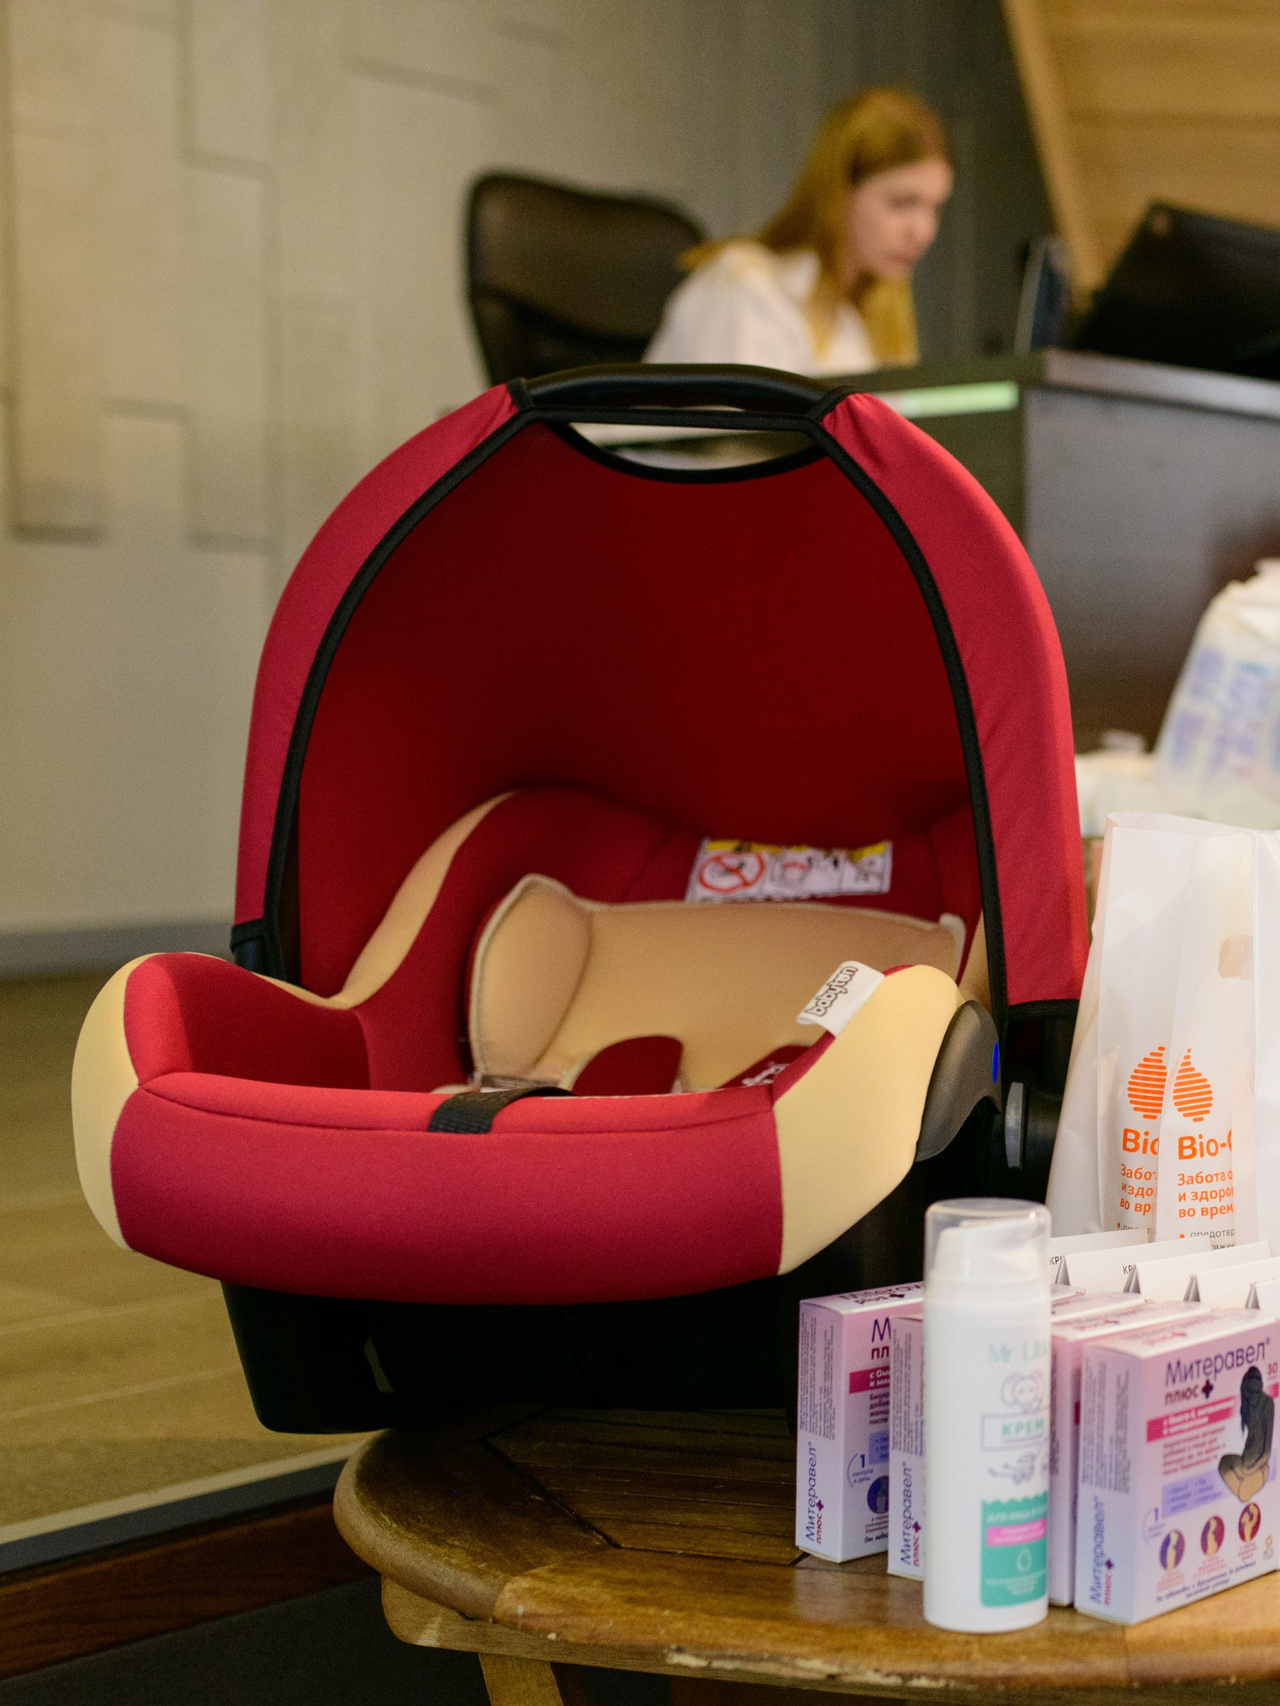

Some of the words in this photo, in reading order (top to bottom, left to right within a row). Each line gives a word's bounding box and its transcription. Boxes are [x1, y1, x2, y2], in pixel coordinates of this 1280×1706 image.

[805, 965, 859, 1017] babyton
[1177, 1171, 1226, 1186] Забота
[1178, 1192, 1187, 1202] и
[1178, 1207, 1196, 1218] во
[1166, 1342, 1265, 1387] Митеравел
[1267, 1362, 1278, 1375] 30
[1165, 1385, 1198, 1406] плюс
[860, 1454, 865, 1468] 1
[806, 1447, 818, 1542] Митеравел
[900, 1467, 914, 1565] Митеравел
